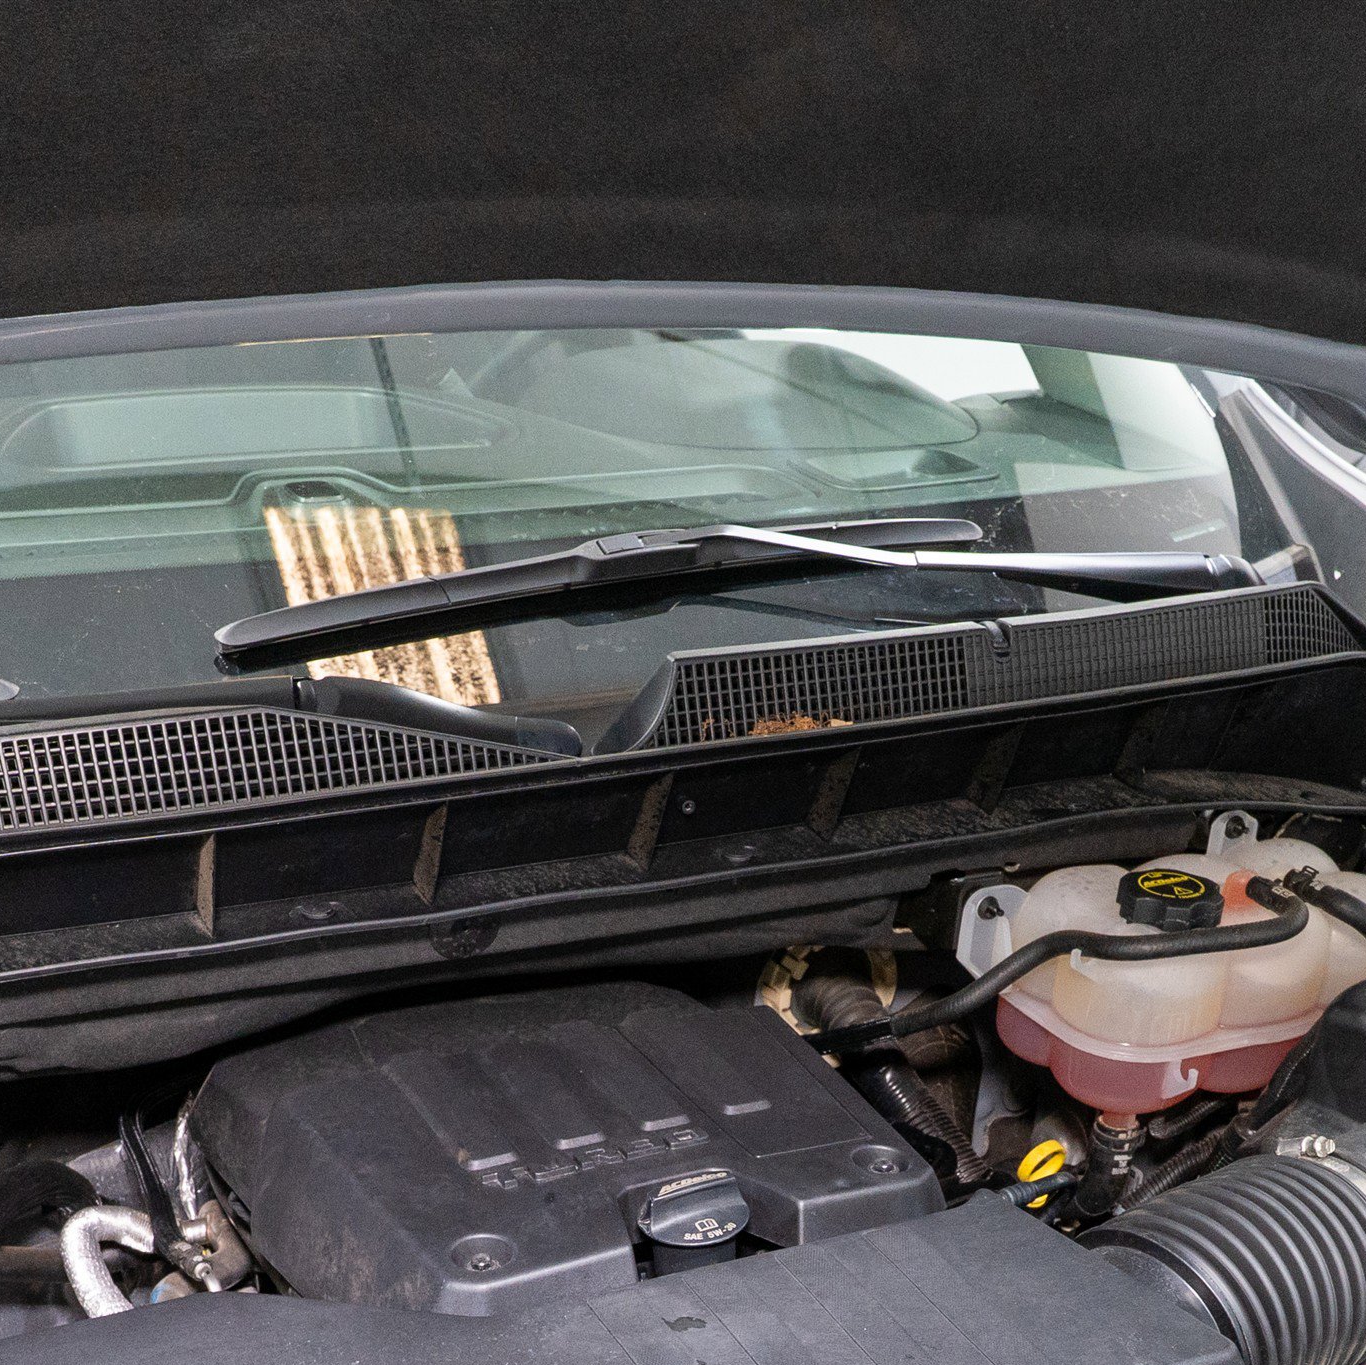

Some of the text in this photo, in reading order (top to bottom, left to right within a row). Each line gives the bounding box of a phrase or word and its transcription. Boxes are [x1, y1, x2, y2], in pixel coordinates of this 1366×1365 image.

[657, 1172, 728, 1197] ACDelco
[683, 1222, 737, 1241] SAE 5W-30
